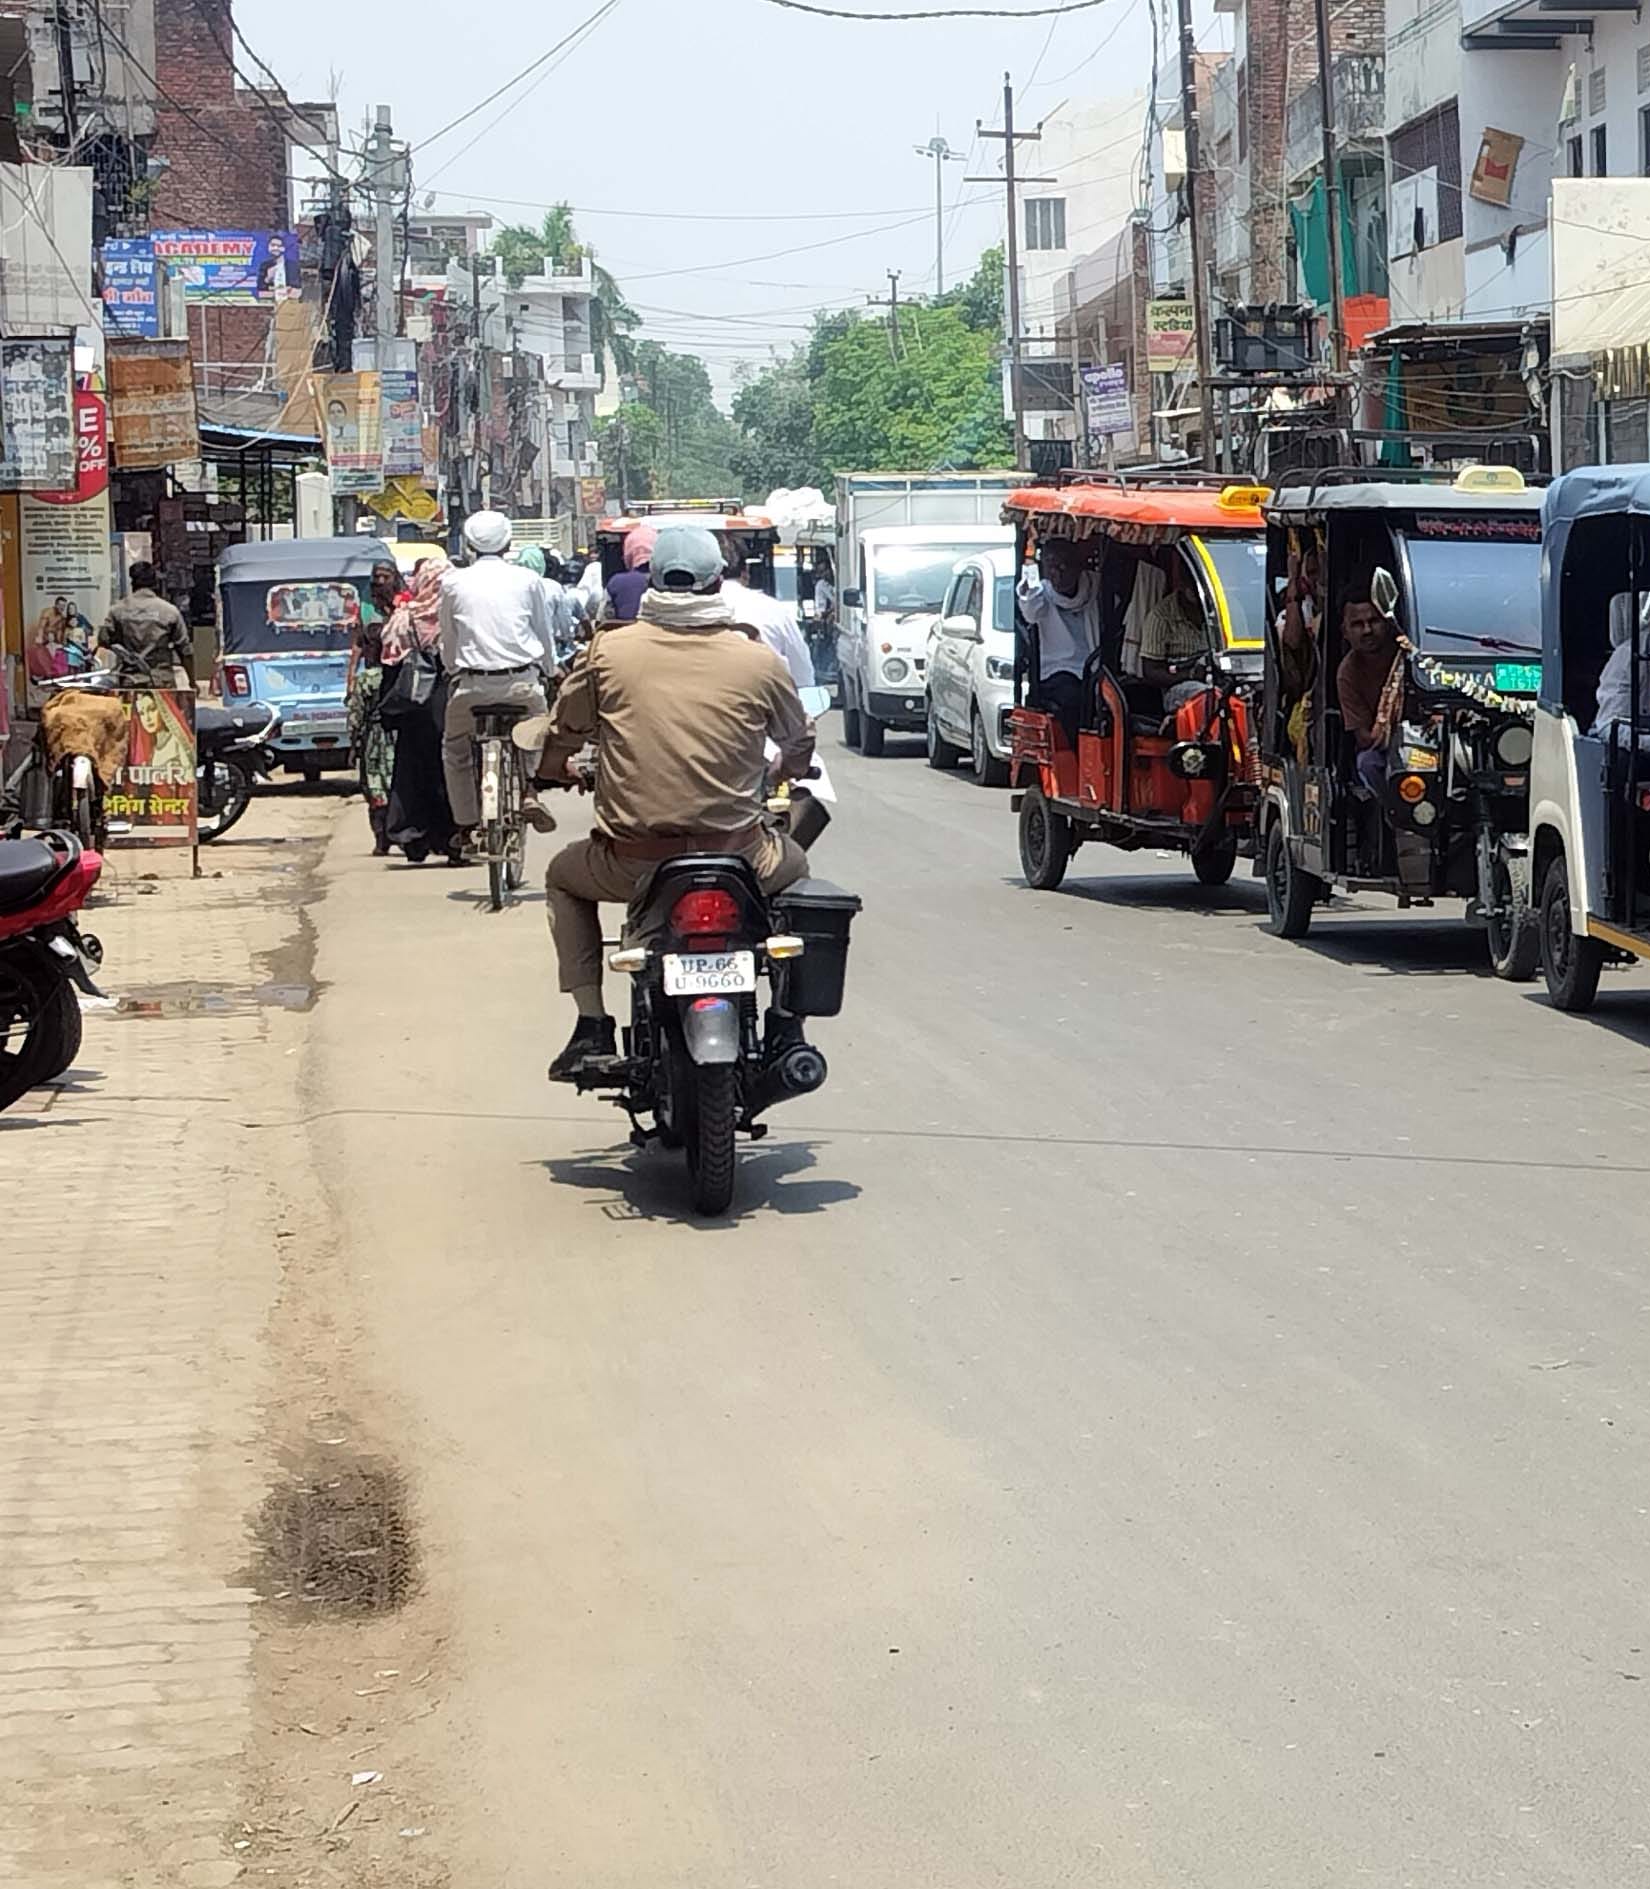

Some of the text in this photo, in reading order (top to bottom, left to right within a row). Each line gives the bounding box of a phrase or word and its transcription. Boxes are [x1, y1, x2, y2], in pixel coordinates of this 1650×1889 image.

[1150, 305, 1193, 317] कल्पना
[1084, 367, 1123, 385] apollo
[79, 459, 107, 473] OFF
